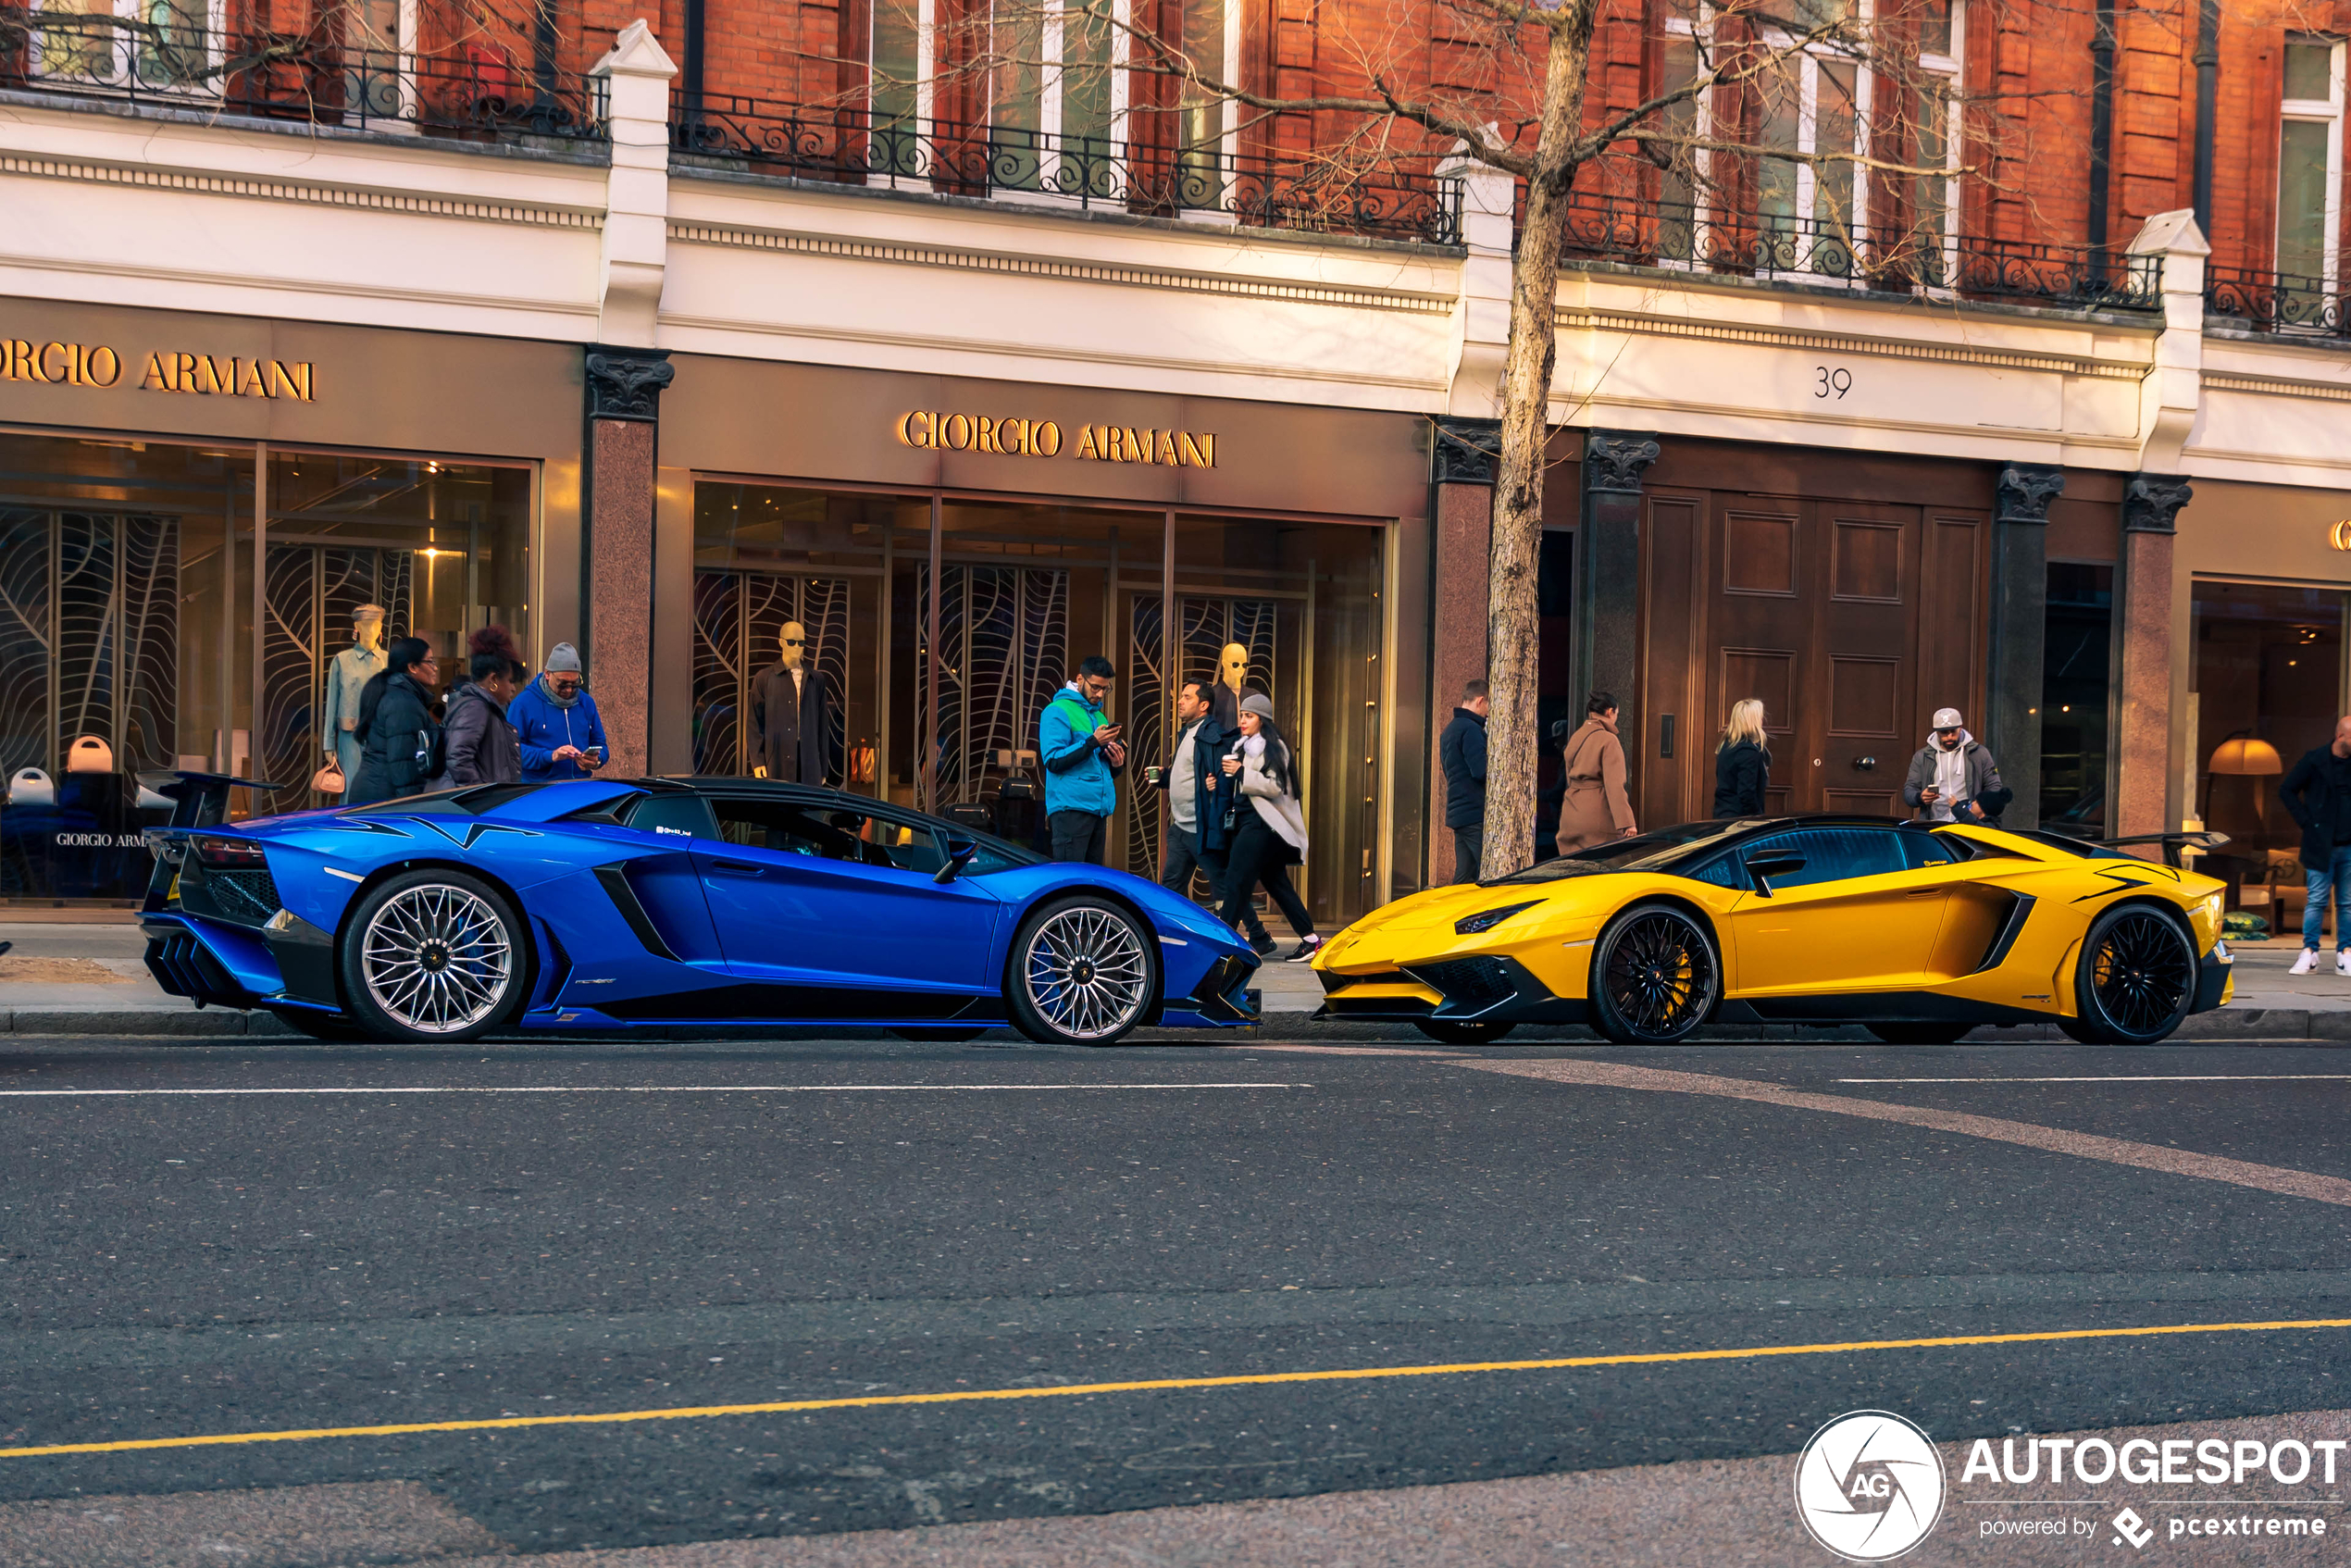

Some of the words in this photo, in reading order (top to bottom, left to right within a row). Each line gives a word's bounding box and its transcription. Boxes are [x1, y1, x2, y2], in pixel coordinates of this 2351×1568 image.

[0, 339, 122, 388] RGIO
[138, 351, 317, 402] ARMANI
[1814, 366, 1852, 400] 39
[902, 410, 1064, 458] GIORGIO
[1075, 422, 1218, 469] ARMANI
[56, 832, 112, 847] GIORGIO
[115, 834, 148, 848] ARM
